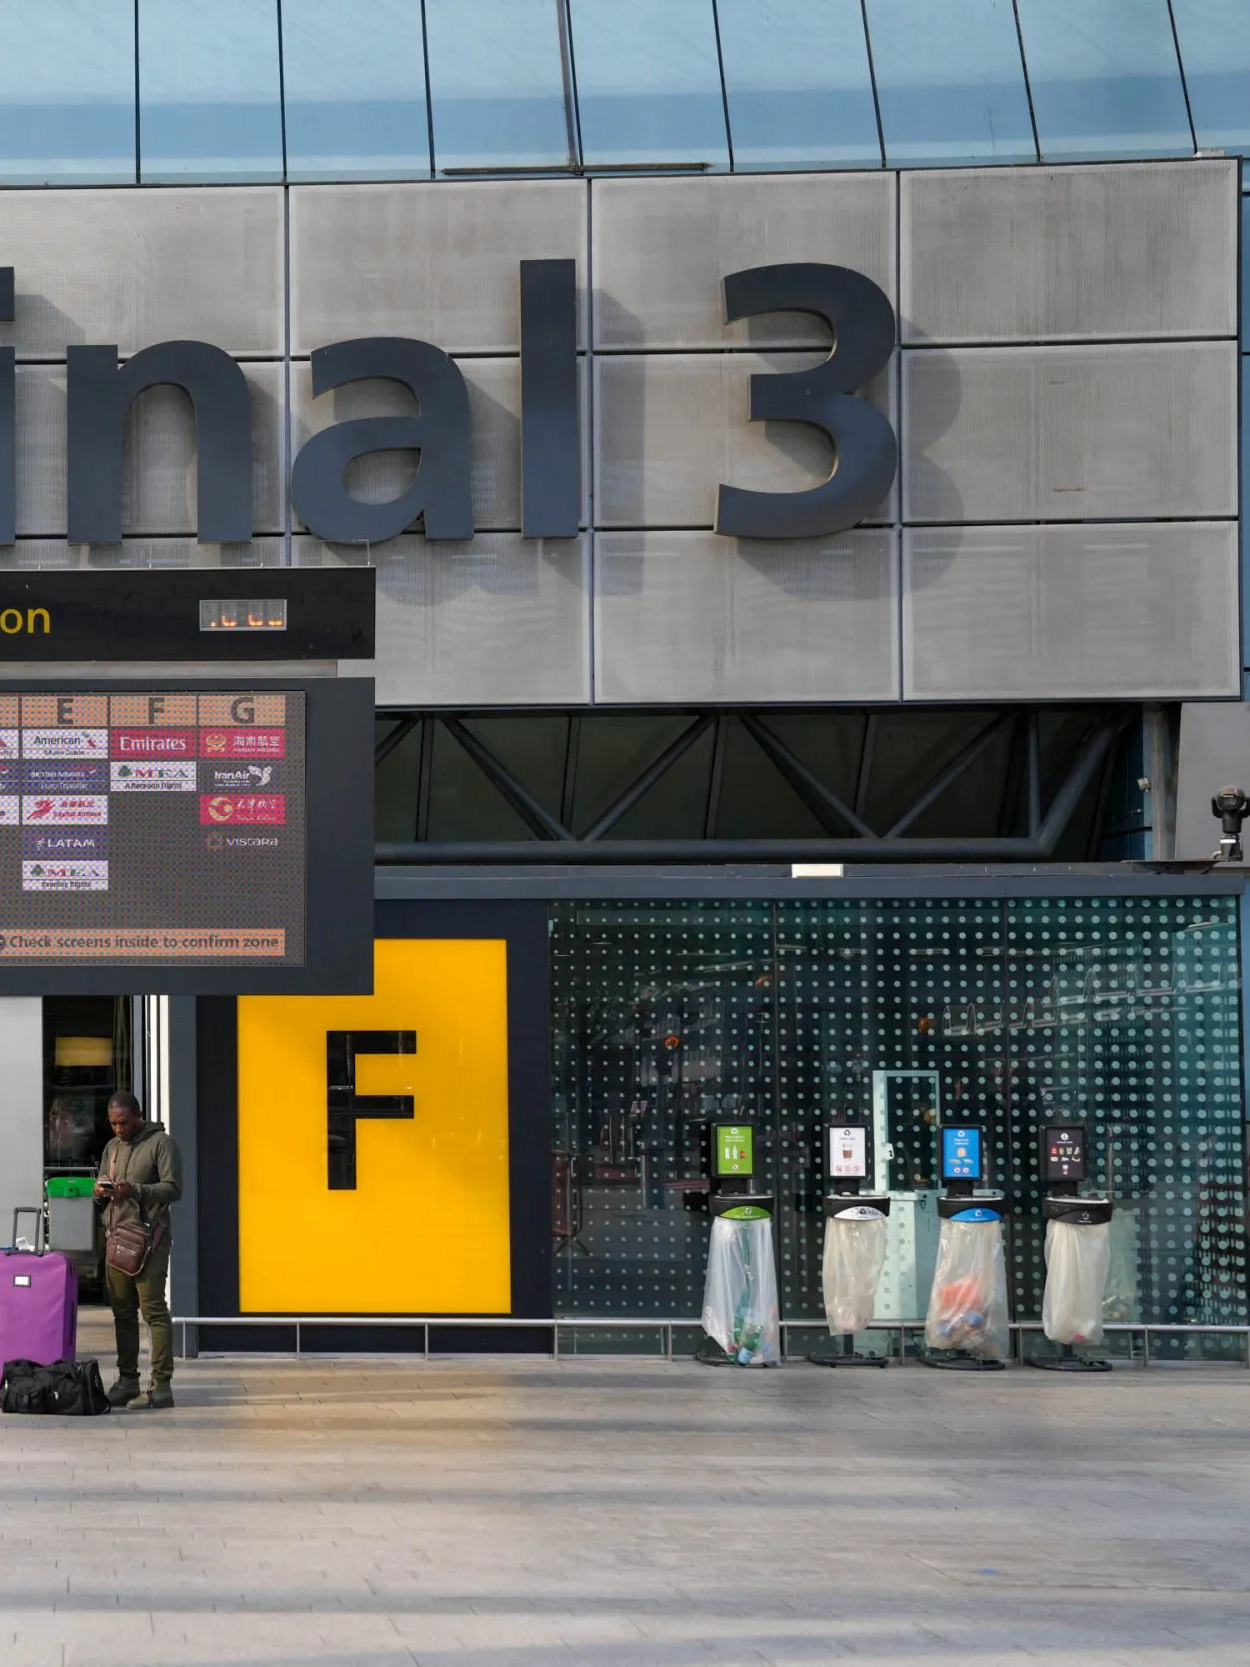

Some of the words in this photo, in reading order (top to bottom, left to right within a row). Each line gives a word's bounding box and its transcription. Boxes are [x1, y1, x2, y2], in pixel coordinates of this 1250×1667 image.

[714, 262, 897, 540] 3
[57, 698, 74, 725] E
[148, 697, 165, 724] F
[230, 697, 255, 724] G
[33, 736, 81, 745] American
[119, 736, 187, 751] Emirates
[47, 838, 96, 848] LATAM
[10, 935, 51, 948] Check
[56, 937, 110, 948] screens
[115, 934, 159, 948] inside
[163, 936, 178, 948] to
[182, 934, 239, 948] confirm
[243, 937, 279, 948] zone
[326, 1030, 417, 1190] F
